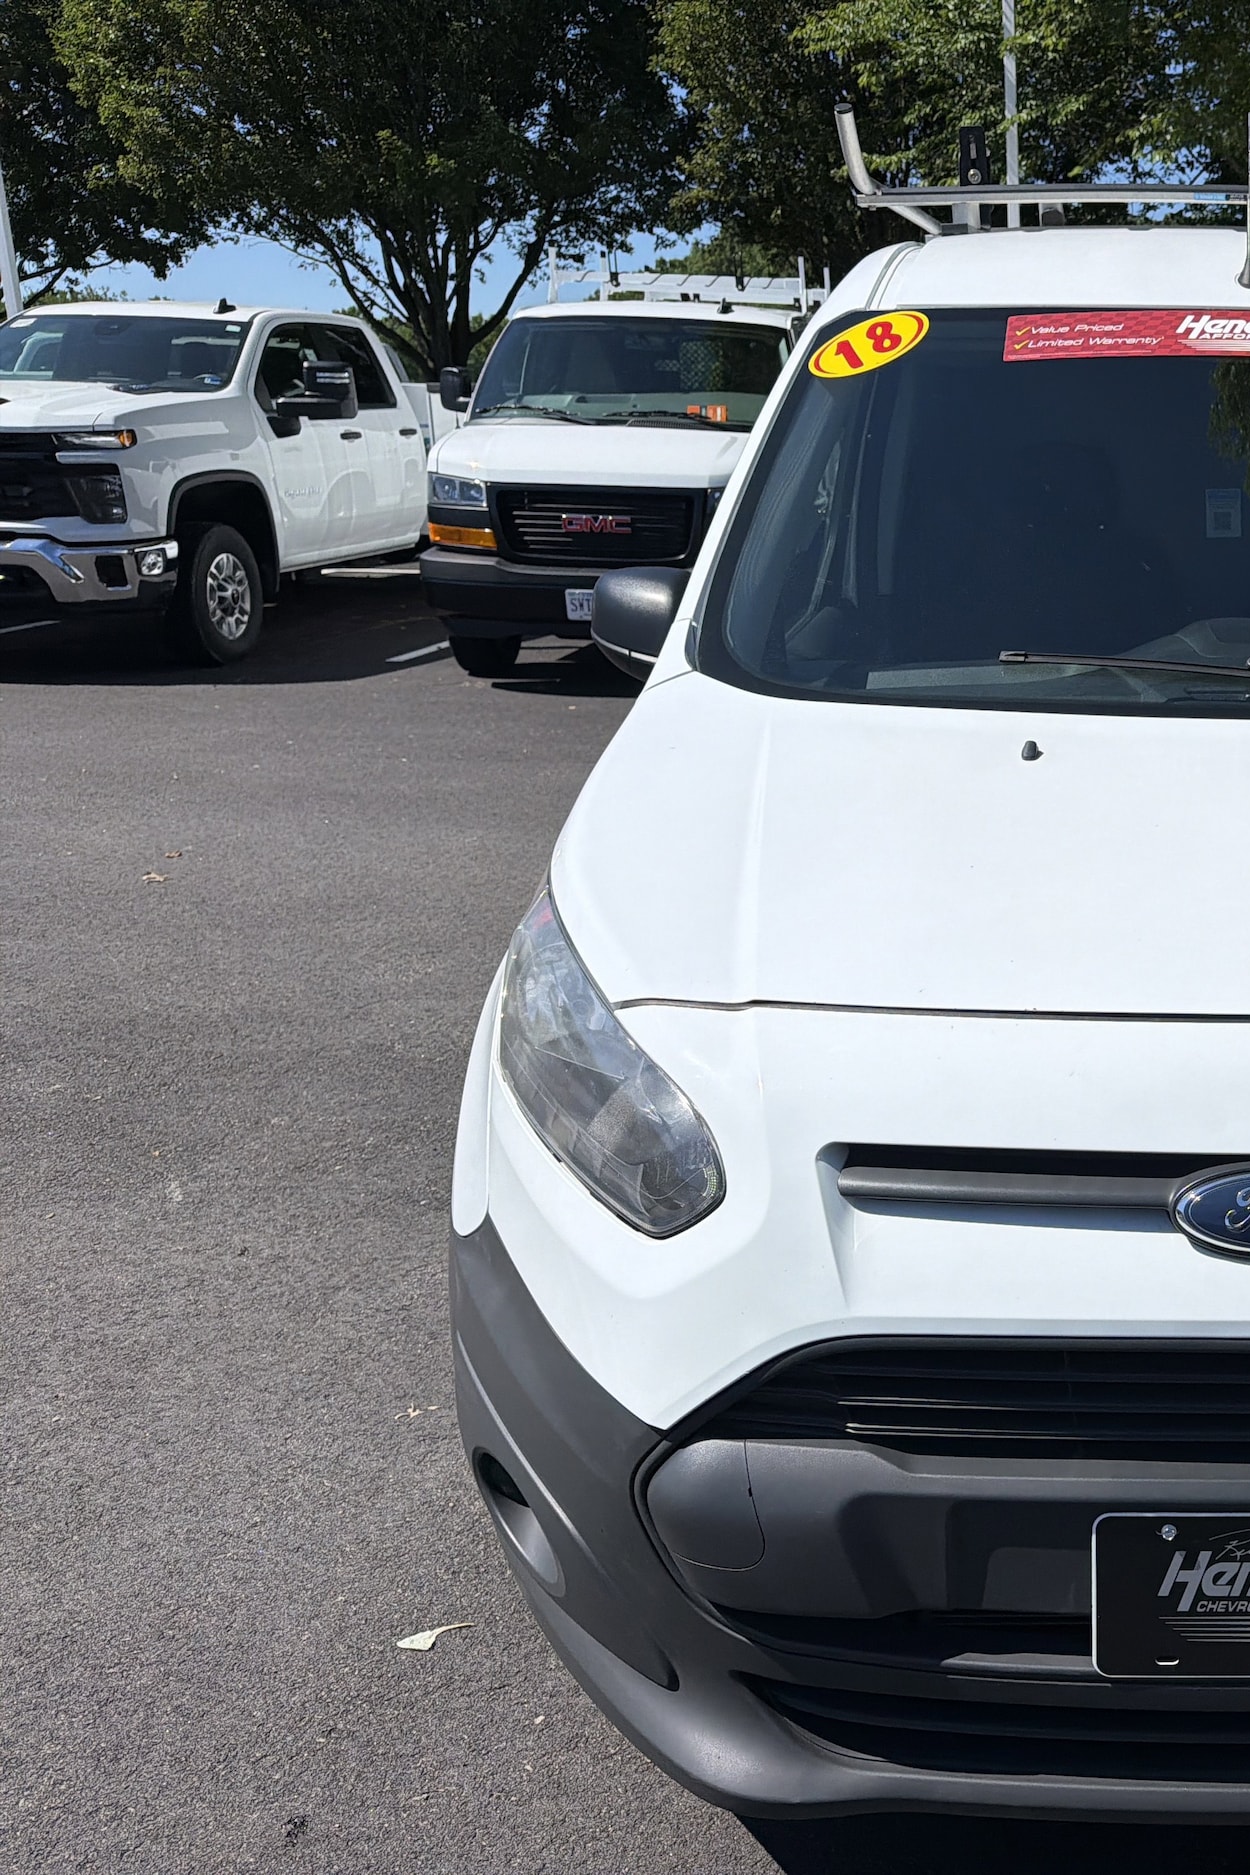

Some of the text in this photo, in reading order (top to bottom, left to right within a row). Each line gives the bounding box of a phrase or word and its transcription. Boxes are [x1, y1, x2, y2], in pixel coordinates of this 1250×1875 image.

[1031, 323, 1125, 335] Value Priced
[835, 321, 903, 369] 18
[1027, 337, 1084, 348] Limited
[562, 513, 633, 534] GMC
